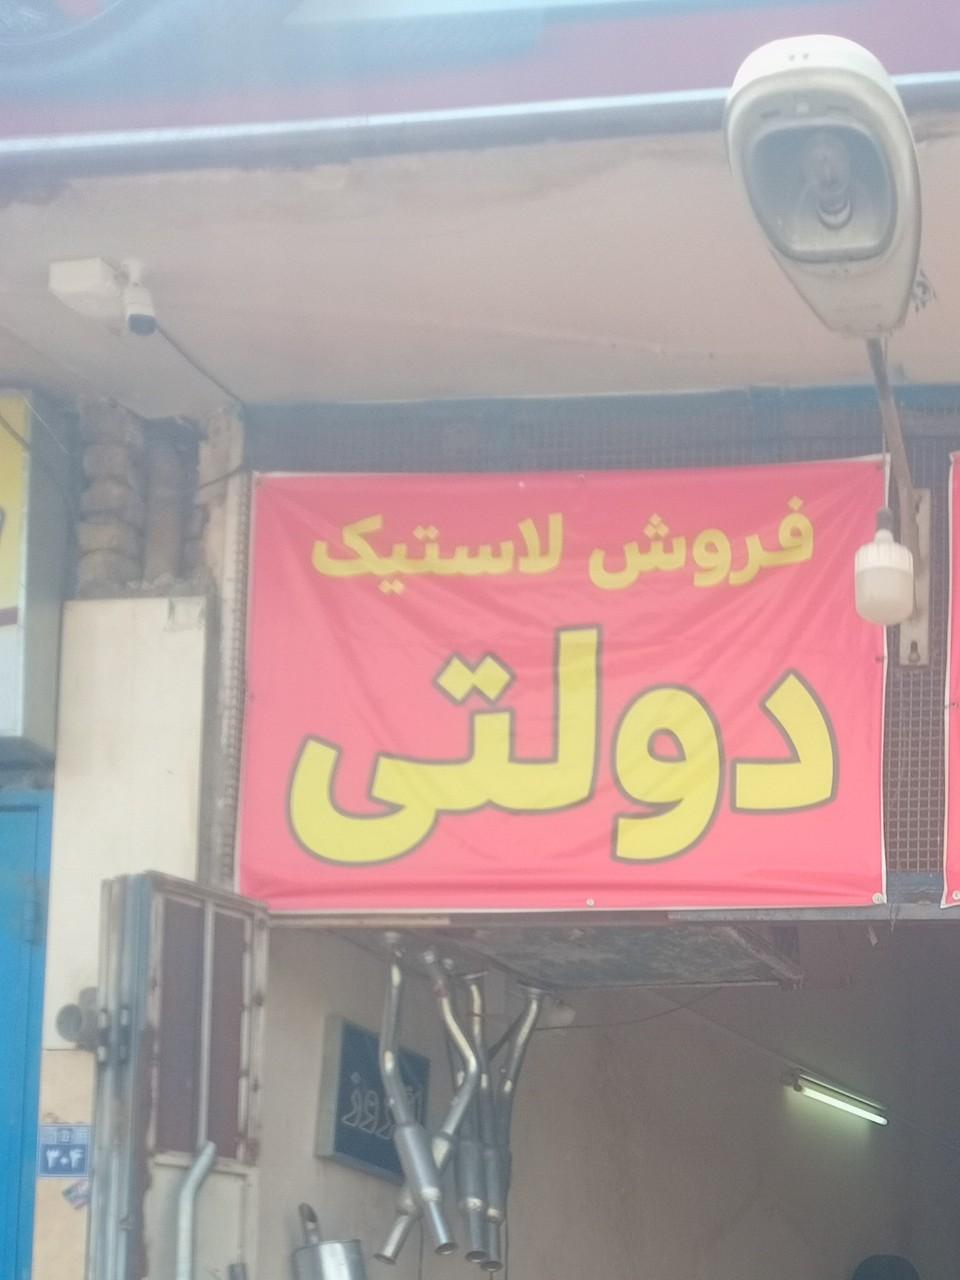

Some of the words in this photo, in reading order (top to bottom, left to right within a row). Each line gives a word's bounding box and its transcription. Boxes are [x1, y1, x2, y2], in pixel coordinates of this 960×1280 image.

[312, 512, 563, 594] لاستیک
[589, 496, 814, 590] فروش
[287, 624, 839, 866] دولتی
